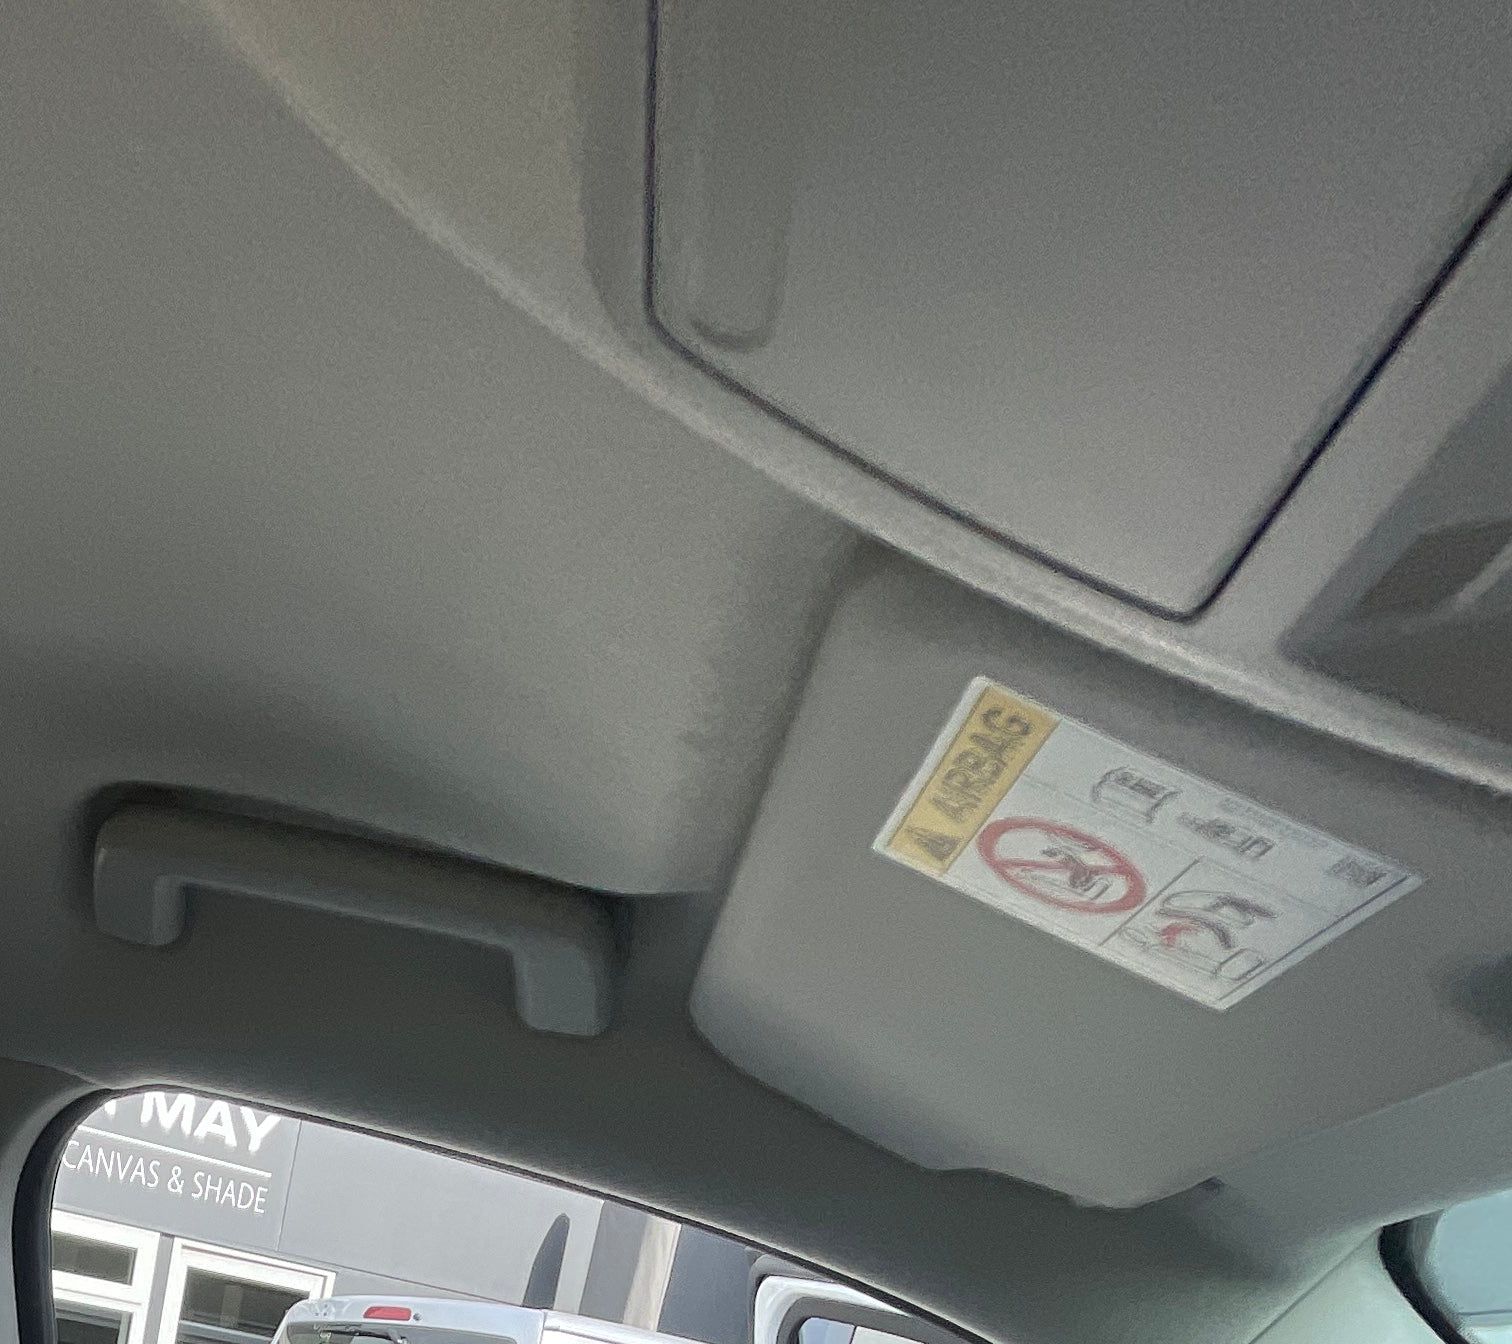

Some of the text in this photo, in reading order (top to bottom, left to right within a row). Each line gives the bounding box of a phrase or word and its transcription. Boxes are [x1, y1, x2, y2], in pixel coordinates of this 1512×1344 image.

[933, 705, 1032, 824] AIRBAG
[141, 1092, 280, 1153] MAY
[62, 1140, 269, 1214] CANVAS & SHADE
